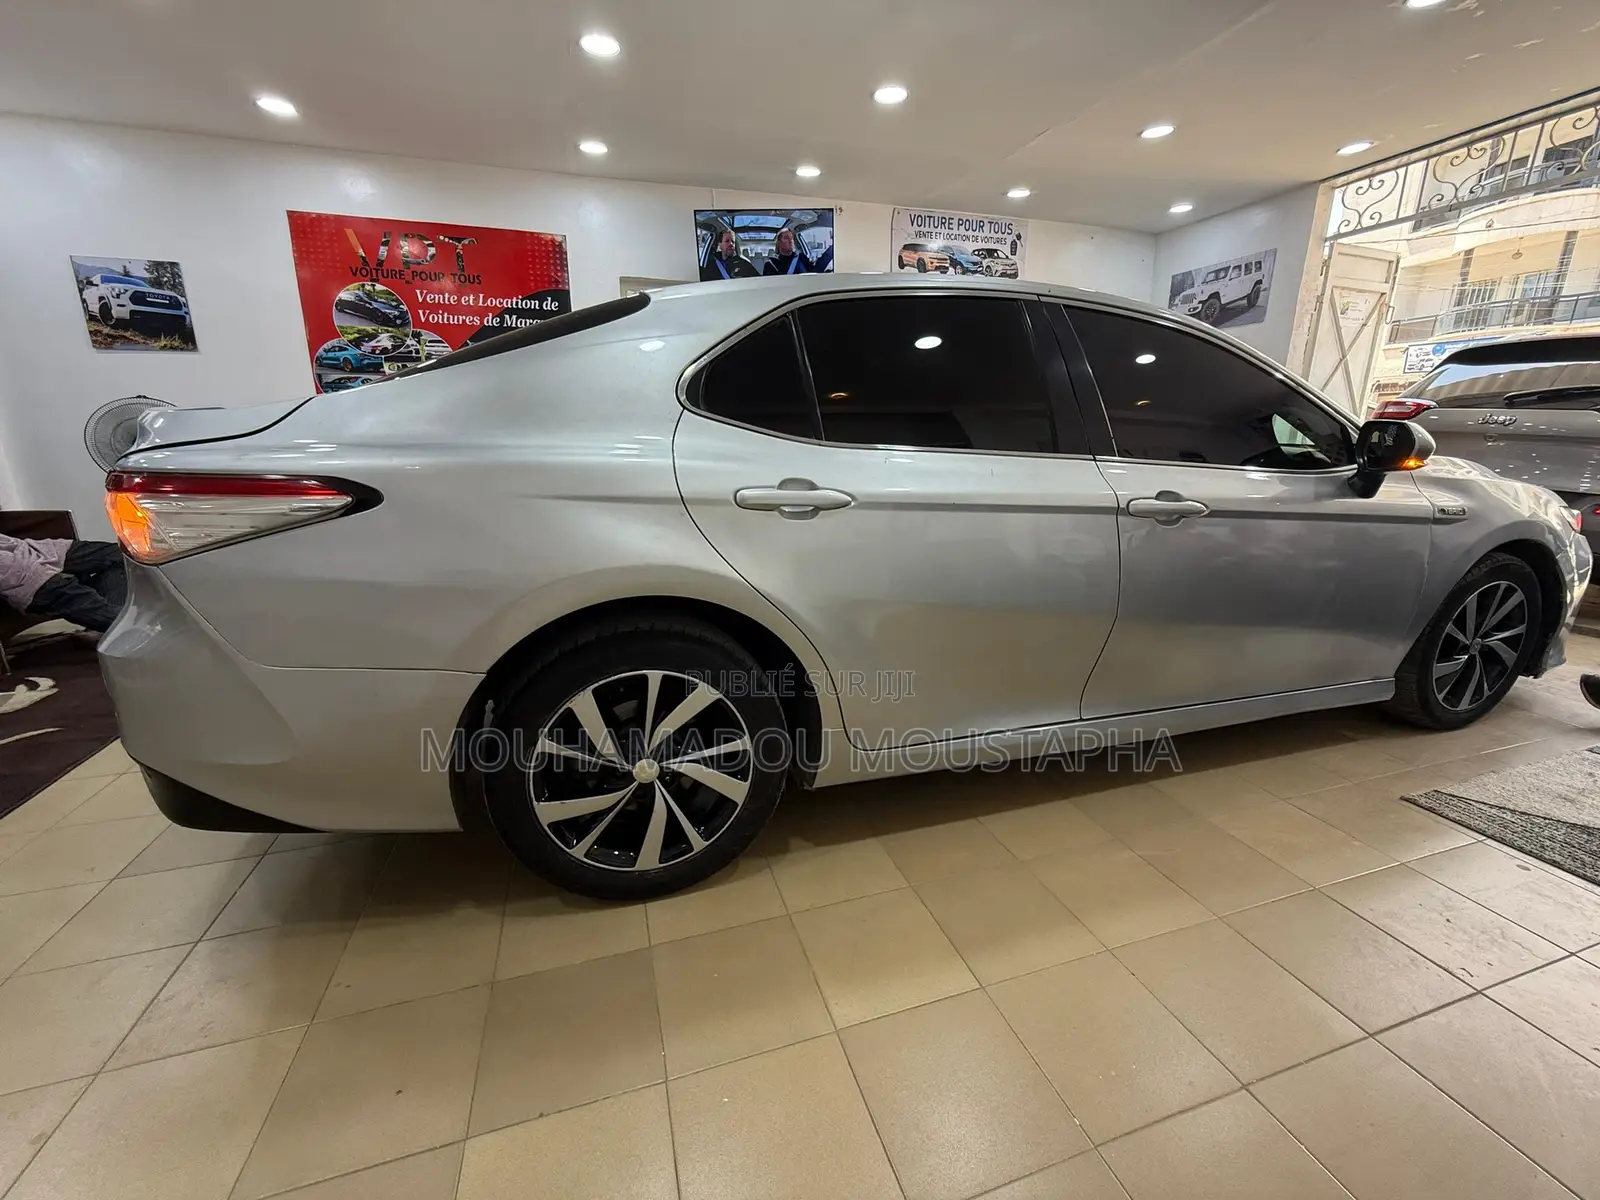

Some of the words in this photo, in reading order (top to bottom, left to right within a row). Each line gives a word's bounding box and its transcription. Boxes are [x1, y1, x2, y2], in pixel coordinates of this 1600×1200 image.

[909, 213, 954, 231] VOITURE
[957, 218, 985, 234] POUR
[988, 220, 1013, 236] TOUS
[915, 230, 934, 240] VENTE
[935, 232, 942, 241] ET
[943, 232, 970, 242] LOCATION
[972, 234, 979, 243] DE
[981, 235, 1007, 246] VOITURES
[344, 228, 478, 275] VPT
[349, 265, 405, 280] VOITURE
[411, 270, 445, 282] POUR
[450, 272, 482, 285] TOUS
[415, 289, 458, 305] Vente
[461, 294, 475, 306] et
[478, 293, 540, 310] Location
[542, 297, 559, 311] de
[418, 309, 480, 326] Voitures
[483, 313, 500, 327] de
[1477, 413, 1518, 427] Jeep
